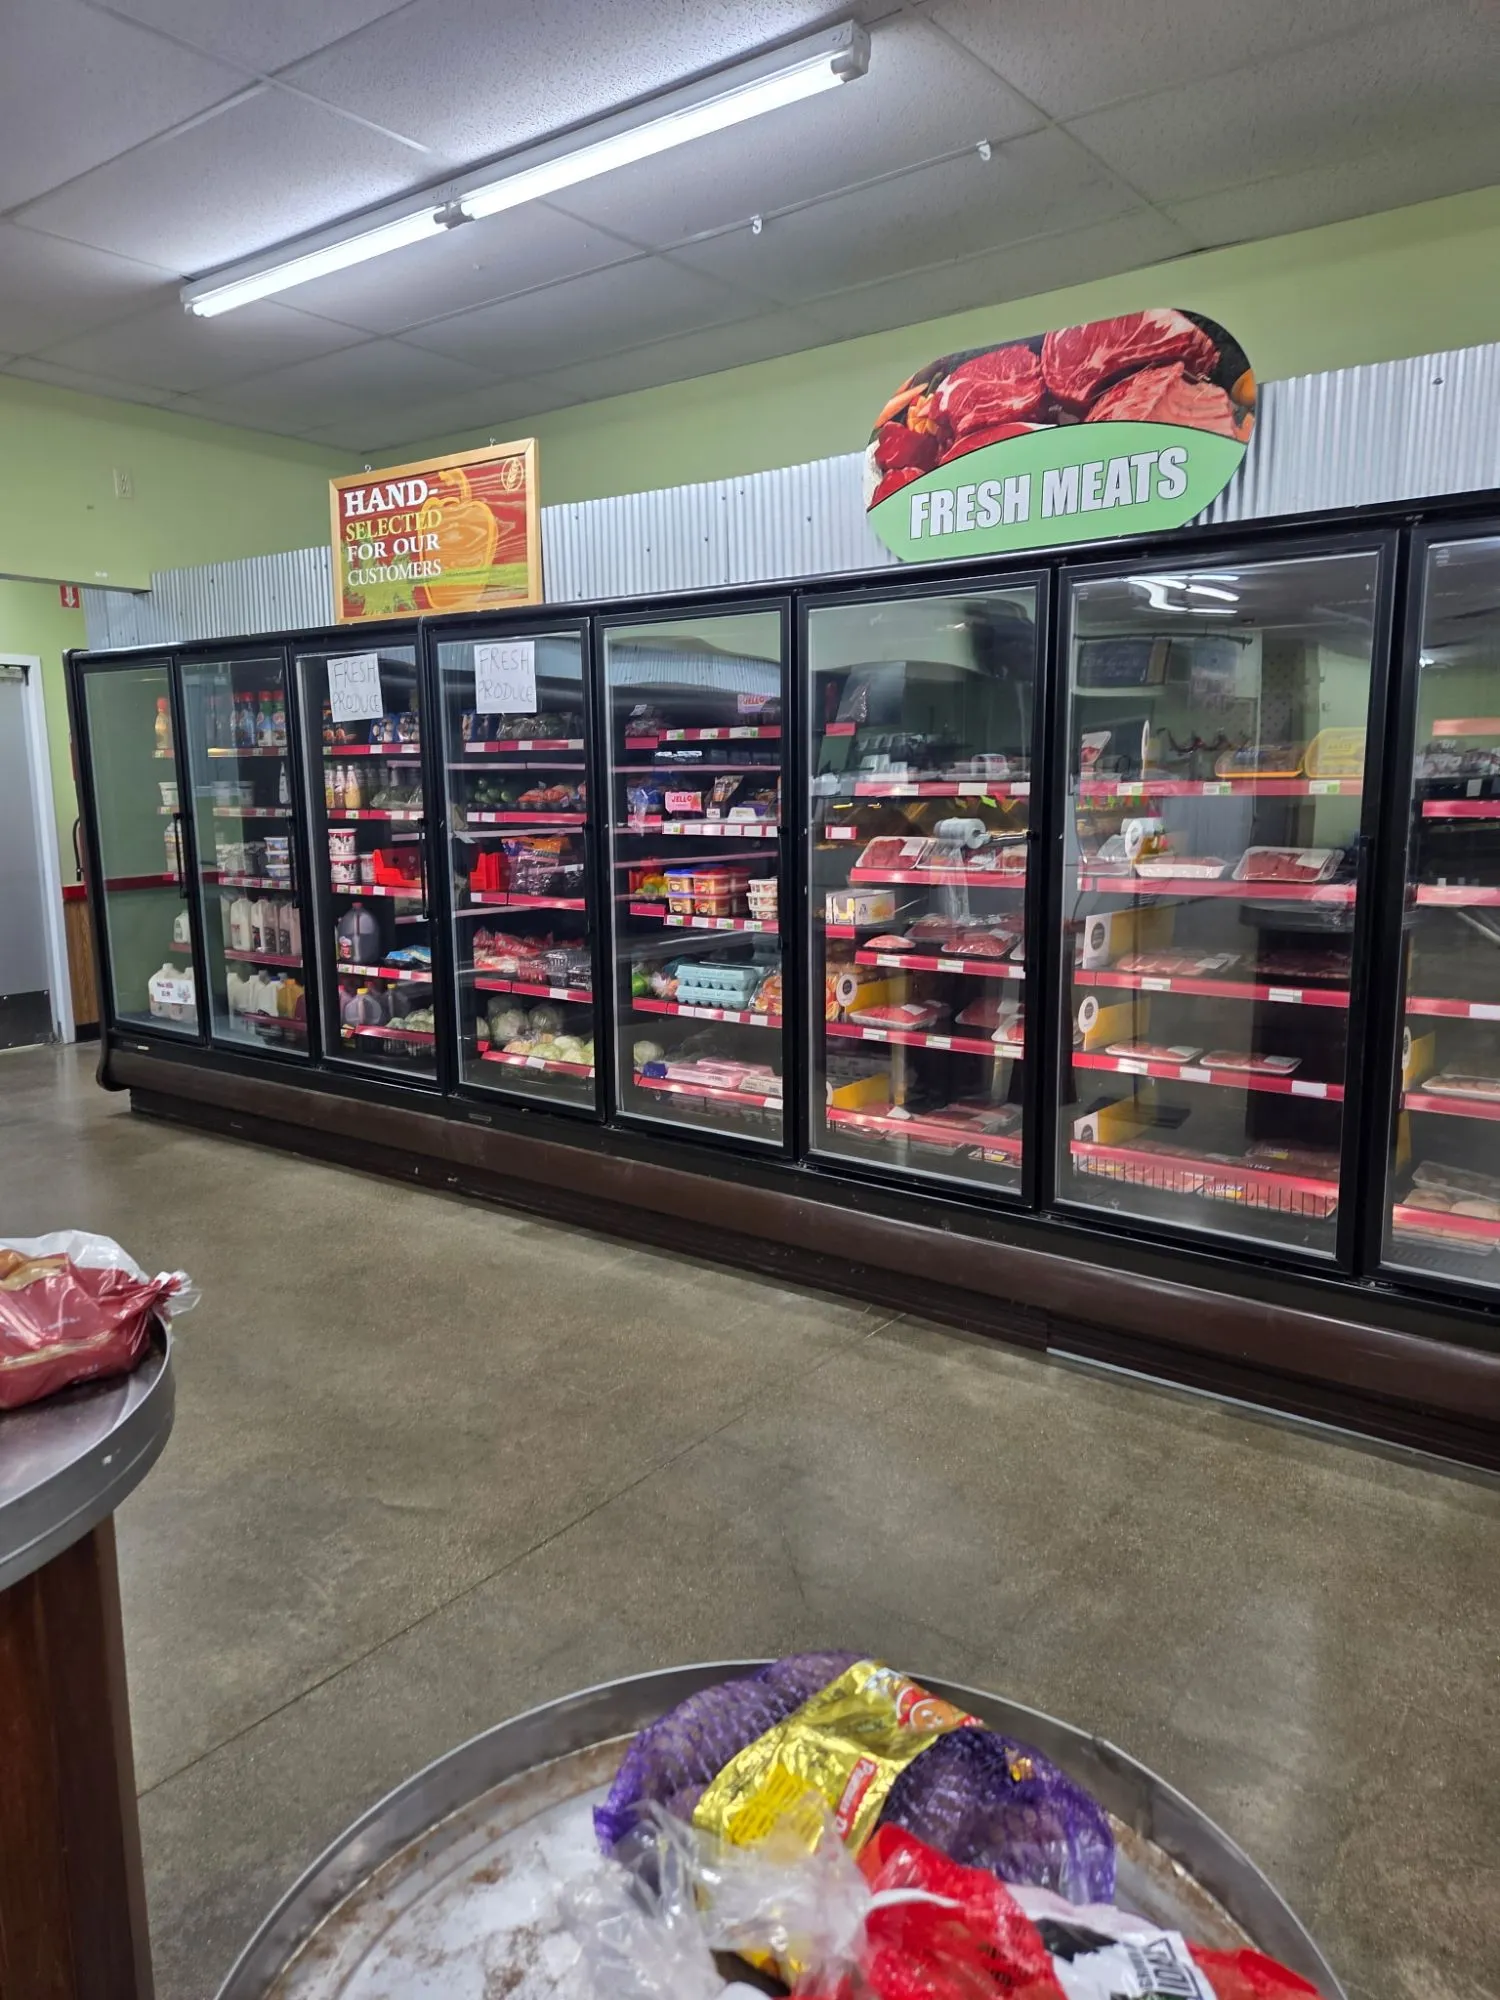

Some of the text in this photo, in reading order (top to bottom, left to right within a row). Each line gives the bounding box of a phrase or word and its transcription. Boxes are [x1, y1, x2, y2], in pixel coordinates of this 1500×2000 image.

[344, 479, 439, 517] HAND-
[910, 446, 1188, 540] FRESH MEATS
[346, 509, 442, 542] SELECTED
[347, 533, 440, 563] FOR OUR
[348, 559, 442, 586] CUSTOMERS
[333, 660, 377, 688] FRESH
[479, 647, 529, 675] FRESH
[333, 690, 380, 713] PRODUCE
[478, 680, 533, 703] PRODUCE
